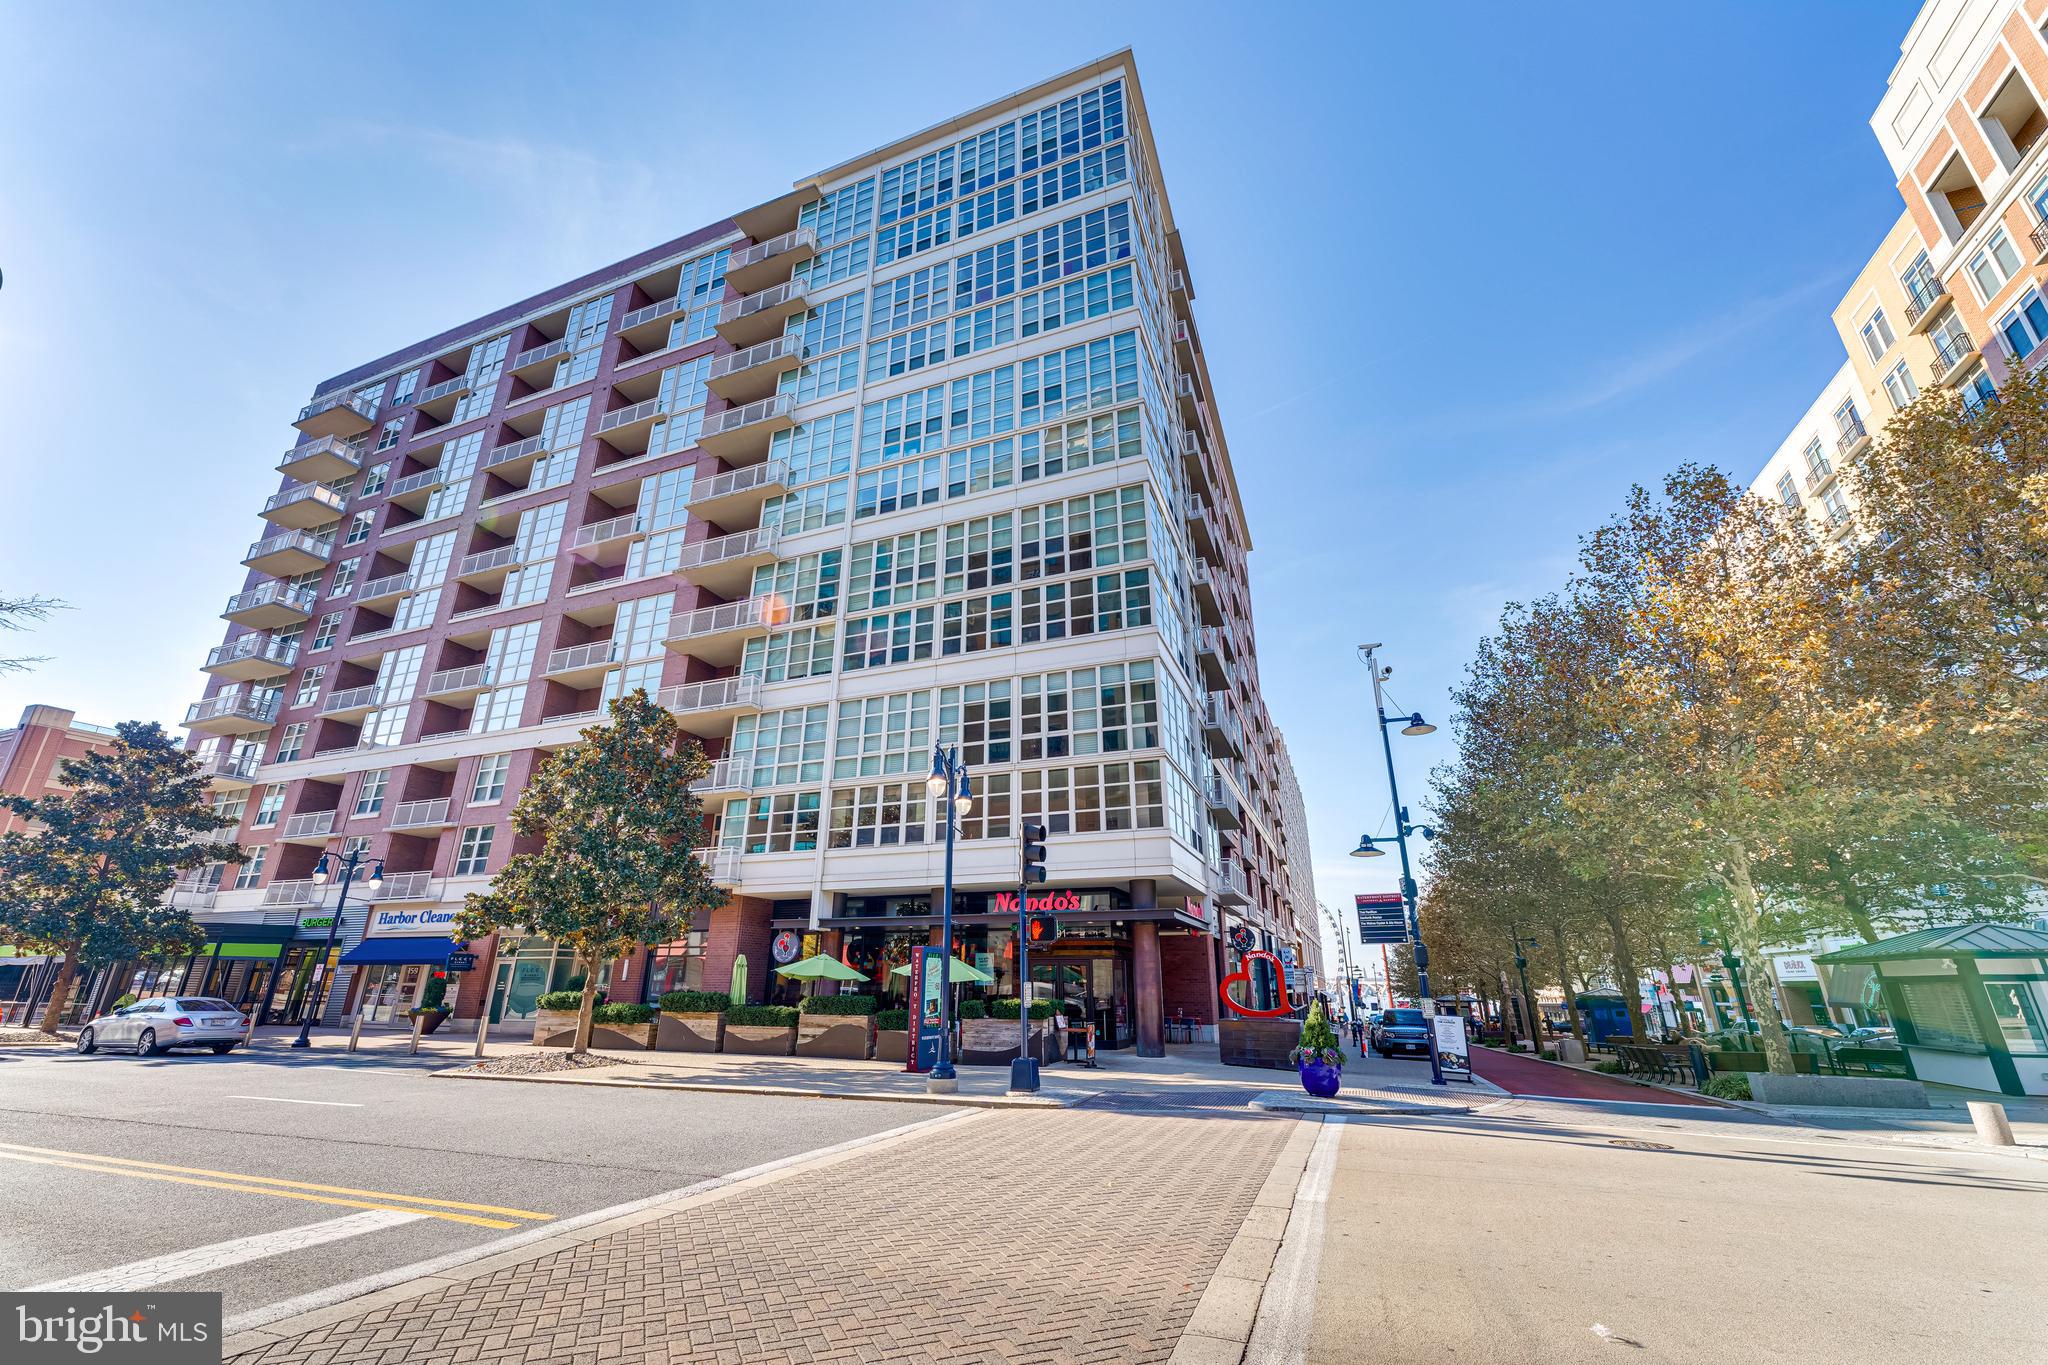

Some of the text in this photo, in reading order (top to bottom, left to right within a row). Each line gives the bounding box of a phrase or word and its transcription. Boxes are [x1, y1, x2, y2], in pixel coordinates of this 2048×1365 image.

[993, 890, 1080, 912] Nando's
[302, 917, 334, 927] BURGER
[378, 911, 418, 924] Harbor
